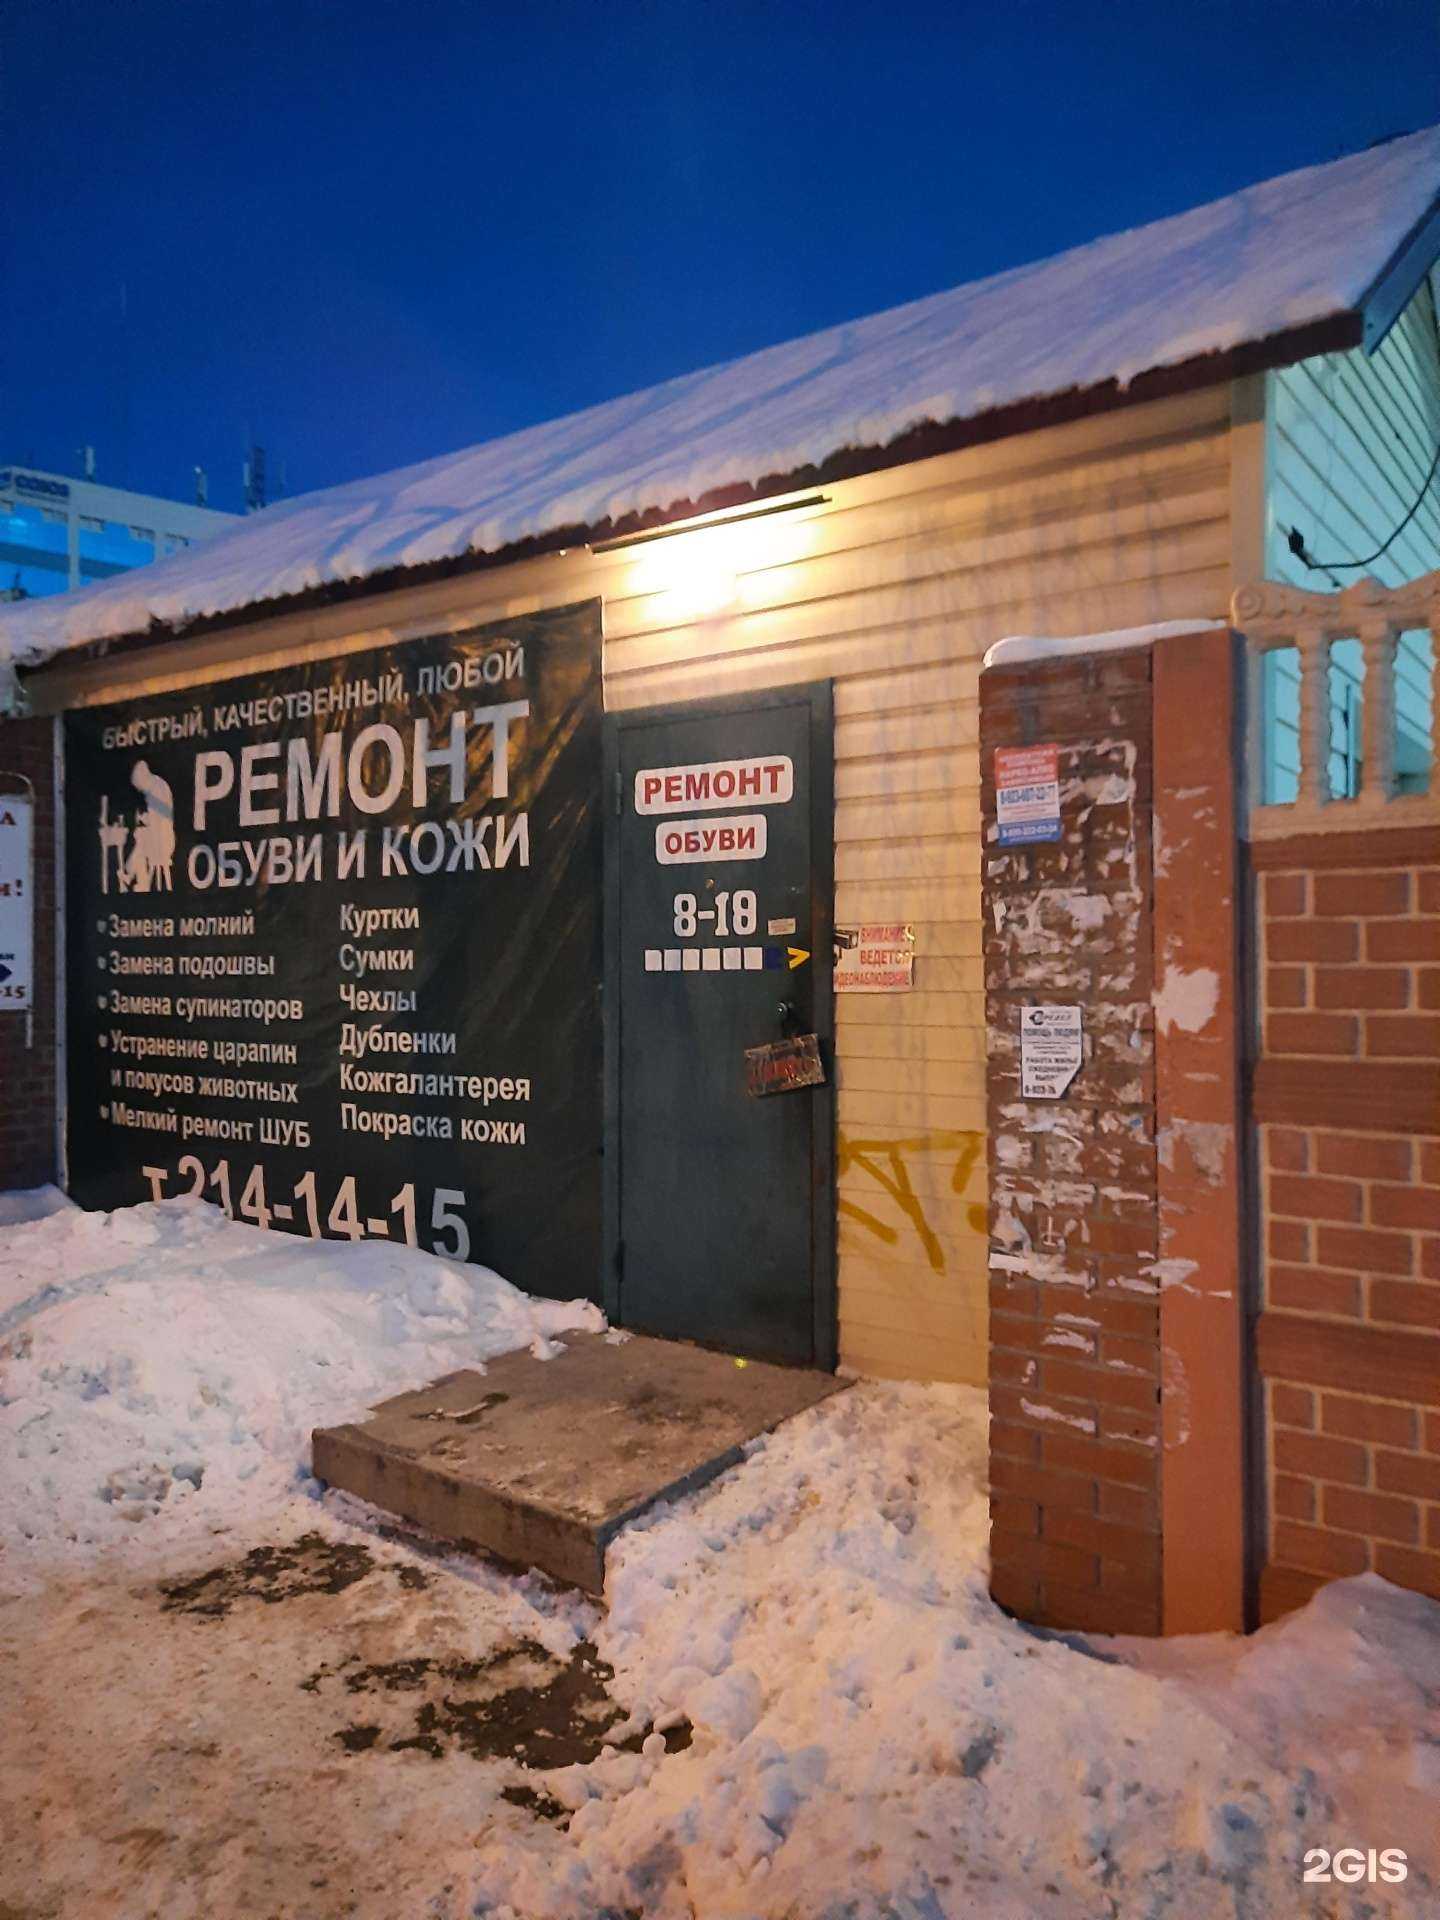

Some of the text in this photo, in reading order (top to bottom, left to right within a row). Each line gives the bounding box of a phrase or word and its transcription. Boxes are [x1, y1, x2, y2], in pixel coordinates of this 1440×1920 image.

[102, 641, 525, 750] БЫСТРЫЙ, КАЧЕСТВЕННЫЙ, ЛЮБОЙ
[193, 700, 529, 831] РЕМОНТ
[643, 765, 785, 804] РЕМОНТ
[187, 812, 530, 889] ОБУВИ И КОЖИ
[664, 827, 756, 855] ОБУВИ
[109, 909, 255, 937] Замена молний
[340, 904, 420, 938] Куртки
[673, 890, 757, 936] 8-18
[109, 951, 275, 979] Замена подошвы
[339, 943, 414, 977] Сумки
[109, 989, 304, 1025] Замена супинаторов
[340, 983, 417, 1012] Чехлы
[111, 1029, 297, 1067] Устранение царапин
[340, 1023, 457, 1058] Дубленки
[111, 1069, 298, 1103] и покусов животных
[340, 1063, 531, 1106] Кожгалантерея
[111, 1101, 311, 1148] Мелкий ремонт ШУБ
[341, 1103, 526, 1145] Покраска кожи
